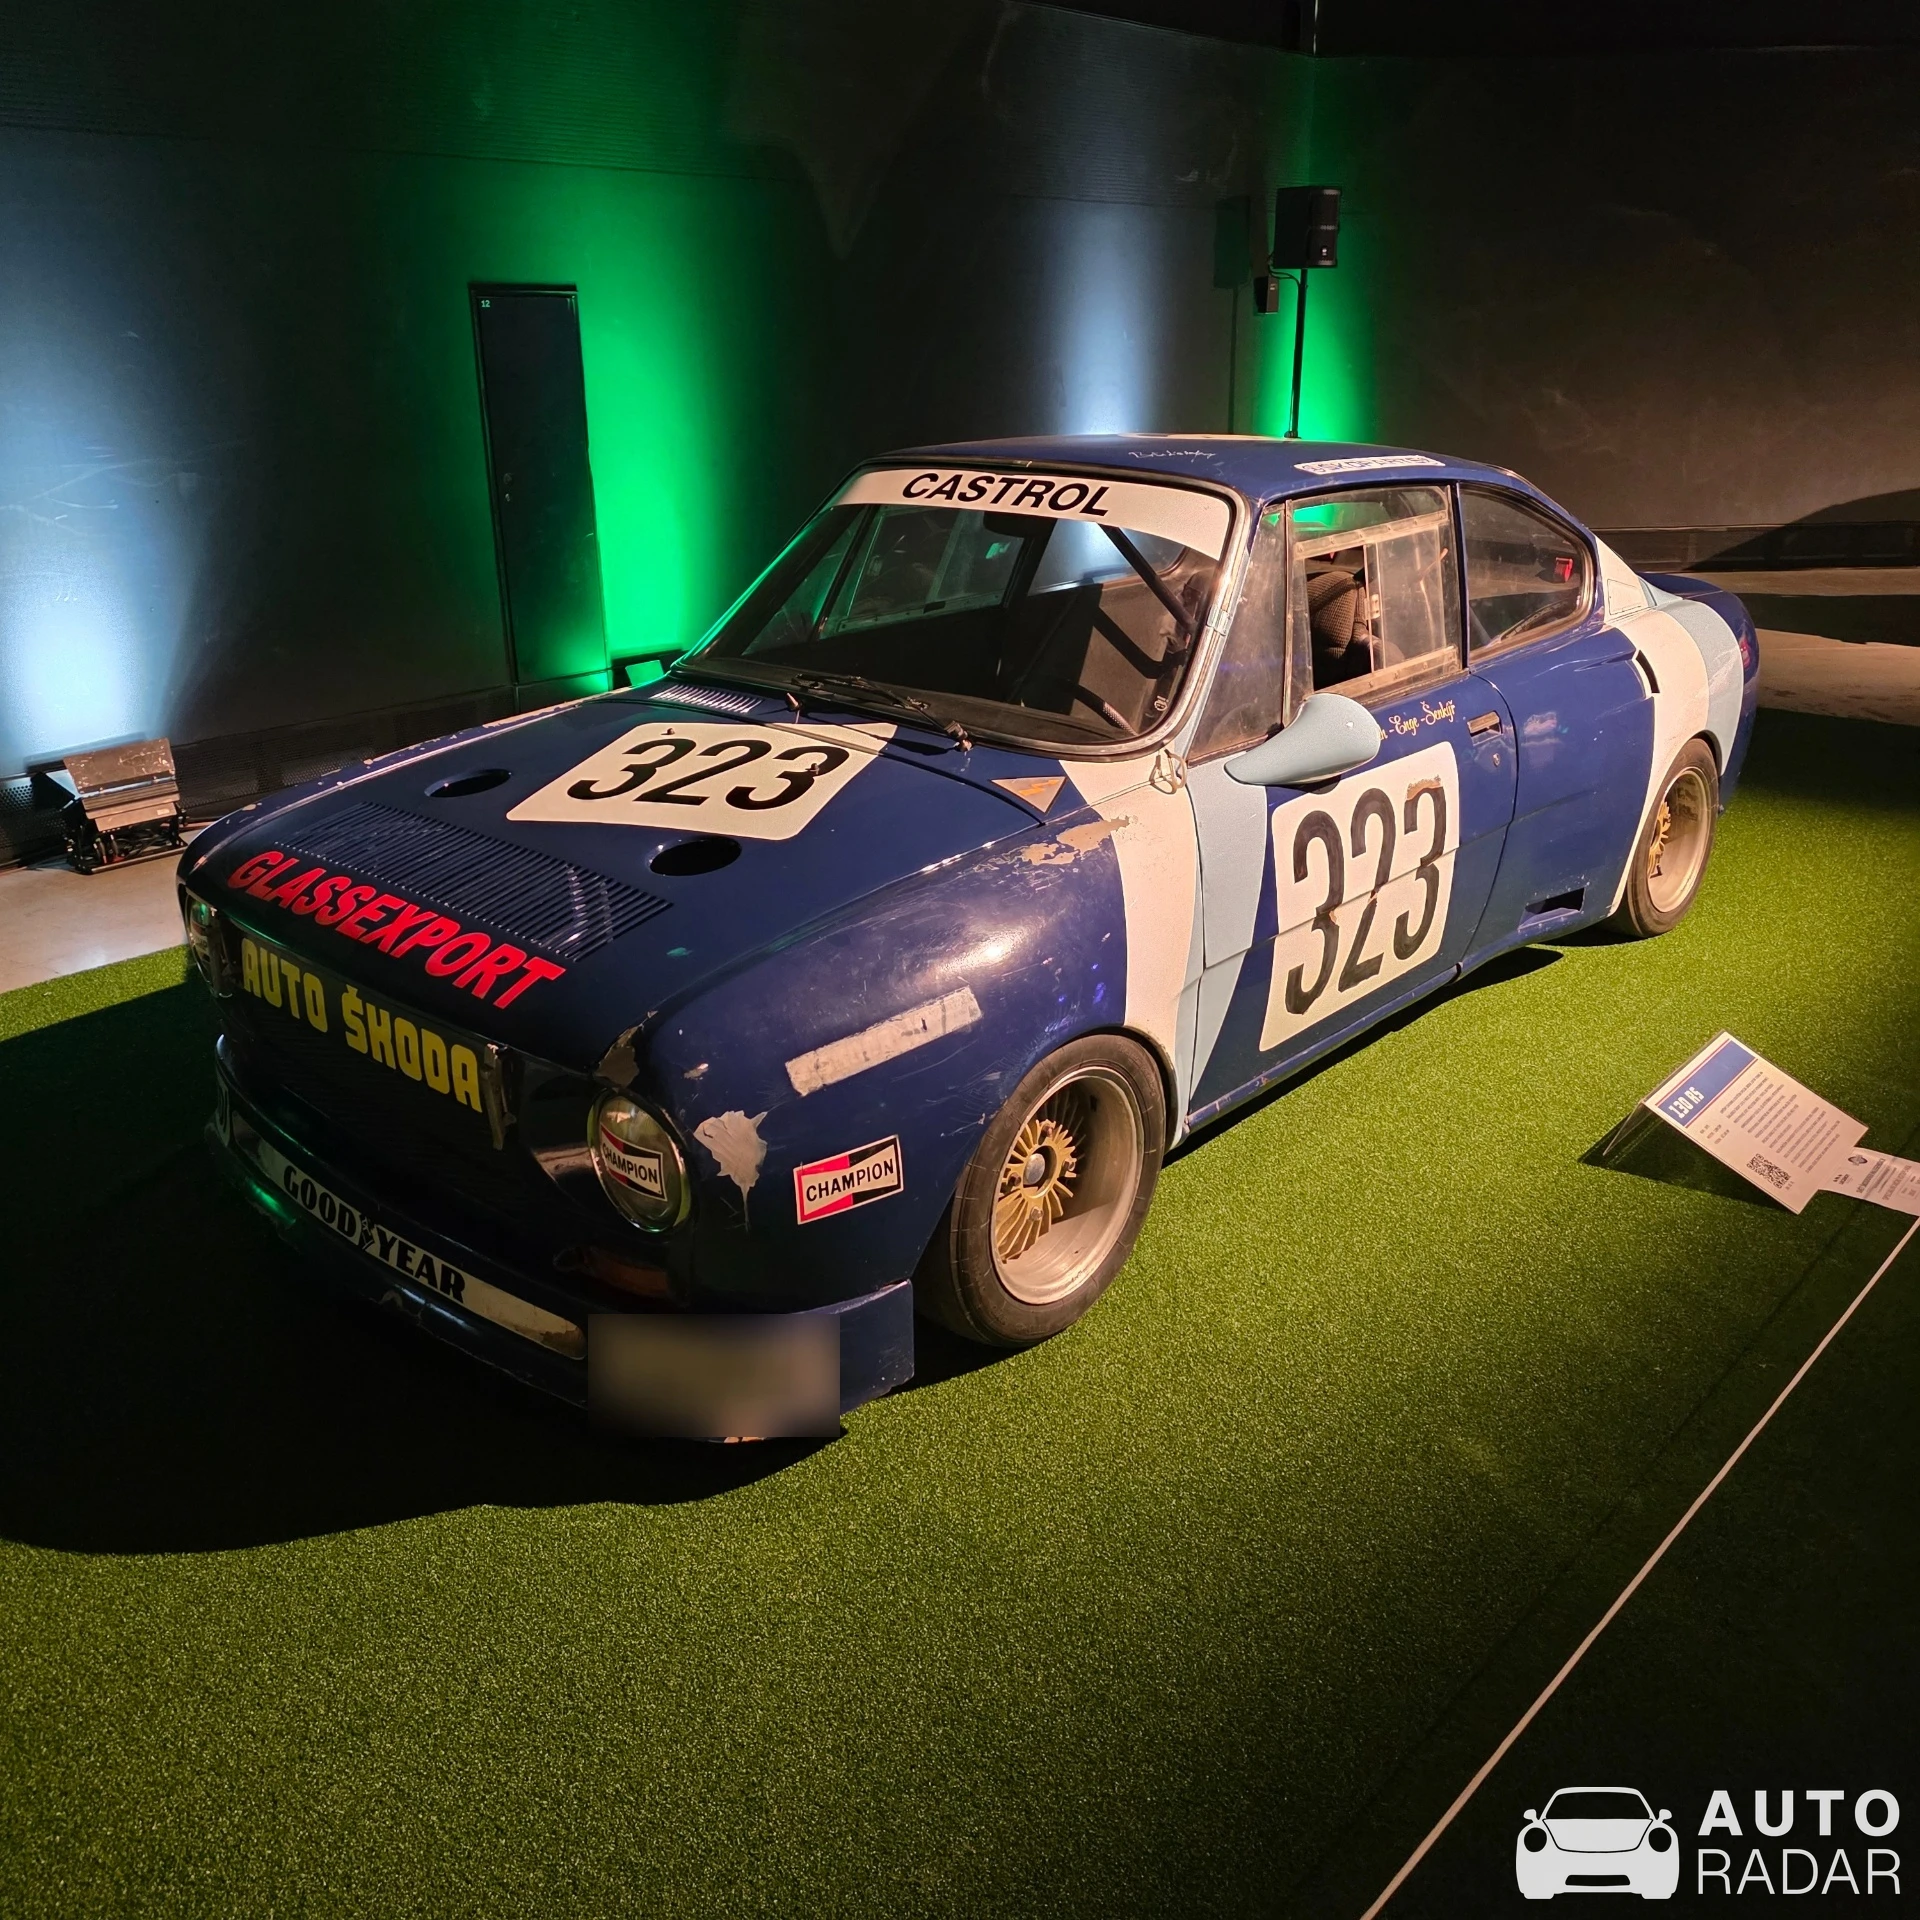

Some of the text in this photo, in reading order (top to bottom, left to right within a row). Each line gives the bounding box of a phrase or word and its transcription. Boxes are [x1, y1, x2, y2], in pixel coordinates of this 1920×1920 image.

[480, 299, 491, 308] 12
[902, 472, 1112, 517] CASTROL
[566, 737, 850, 811] 323
[1285, 785, 1447, 1015] 323
[226, 850, 567, 1010] GLASSEXPORT
[242, 937, 329, 1033] AUTO
[341, 985, 483, 1114] ŠKODA
[1668, 1086, 1705, 1119] 130 RS
[602, 1142, 659, 1185] CHAMPION
[806, 1157, 895, 1203] CHAMPION
